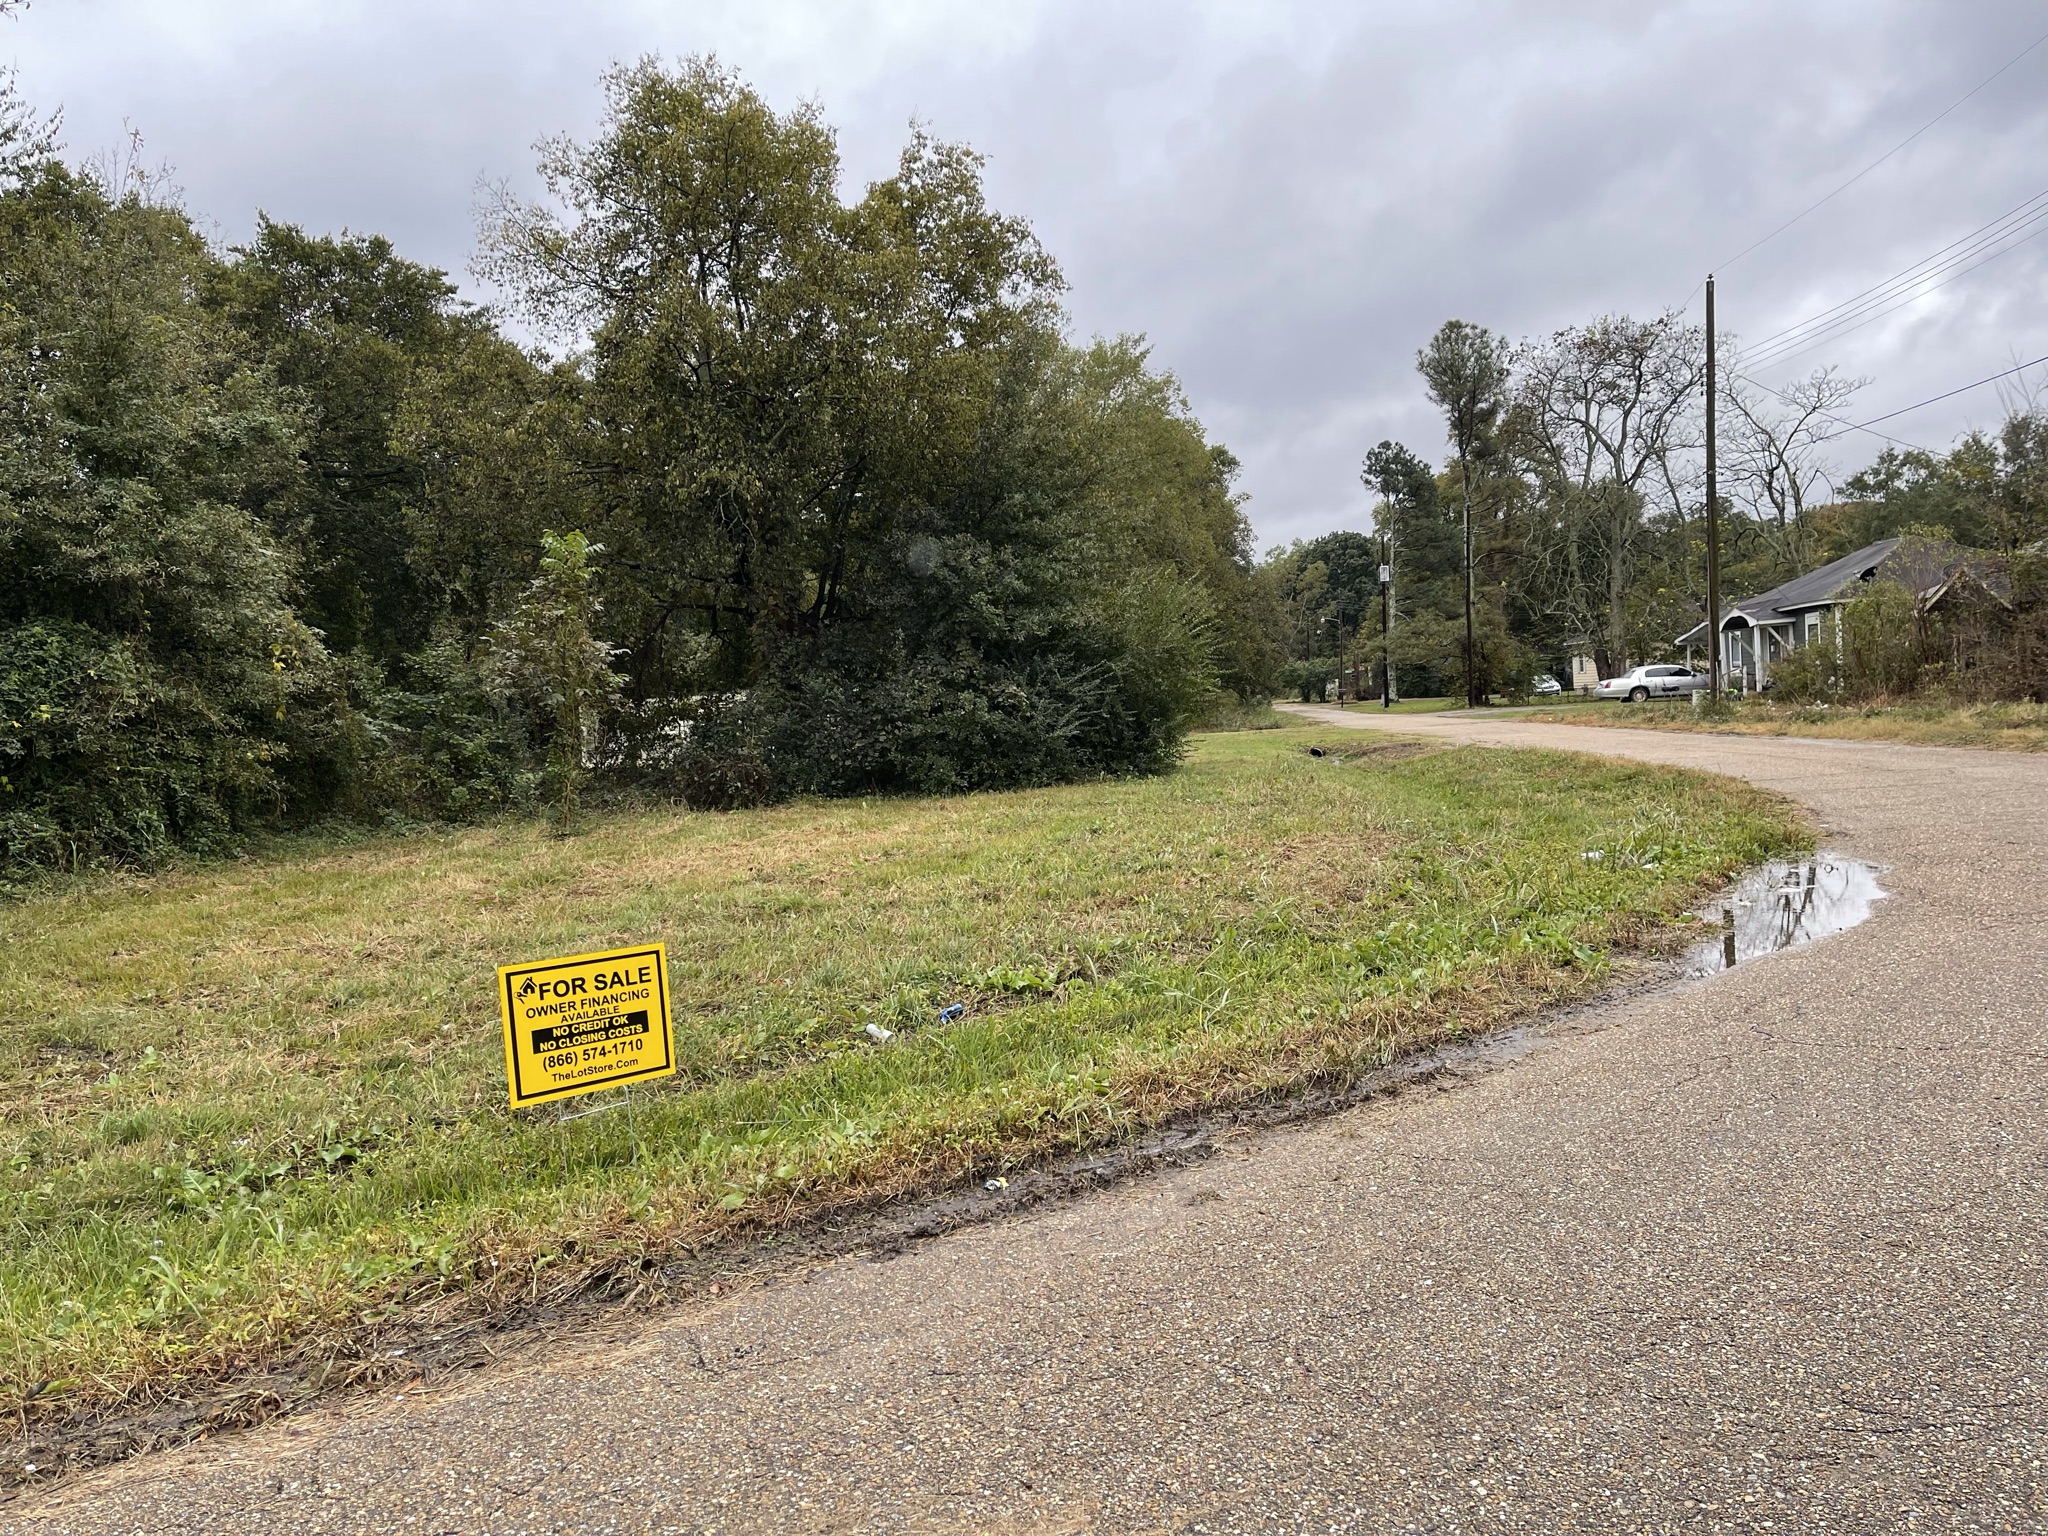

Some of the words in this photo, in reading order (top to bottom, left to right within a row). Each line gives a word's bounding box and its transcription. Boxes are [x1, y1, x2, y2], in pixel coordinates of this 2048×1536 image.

[539, 977, 587, 1000] FOR
[595, 967, 651, 990] SALE
[526, 1001, 576, 1018] OWNER
[581, 989, 649, 1009] FINANCING
[561, 1006, 620, 1023] AVAILABLE
[540, 1041, 556, 1051] NO
[559, 1032, 606, 1047] CLOSING
[609, 1024, 643, 1038] COSTS
[553, 1026, 569, 1037] NO
[572, 1019, 610, 1034] CREDIT
[613, 1015, 628, 1025] OK
[543, 1051, 578, 1071] (866)
[583, 1039, 643, 1061] 574-1710
[552, 1058, 638, 1082] TheLotStore.Com
